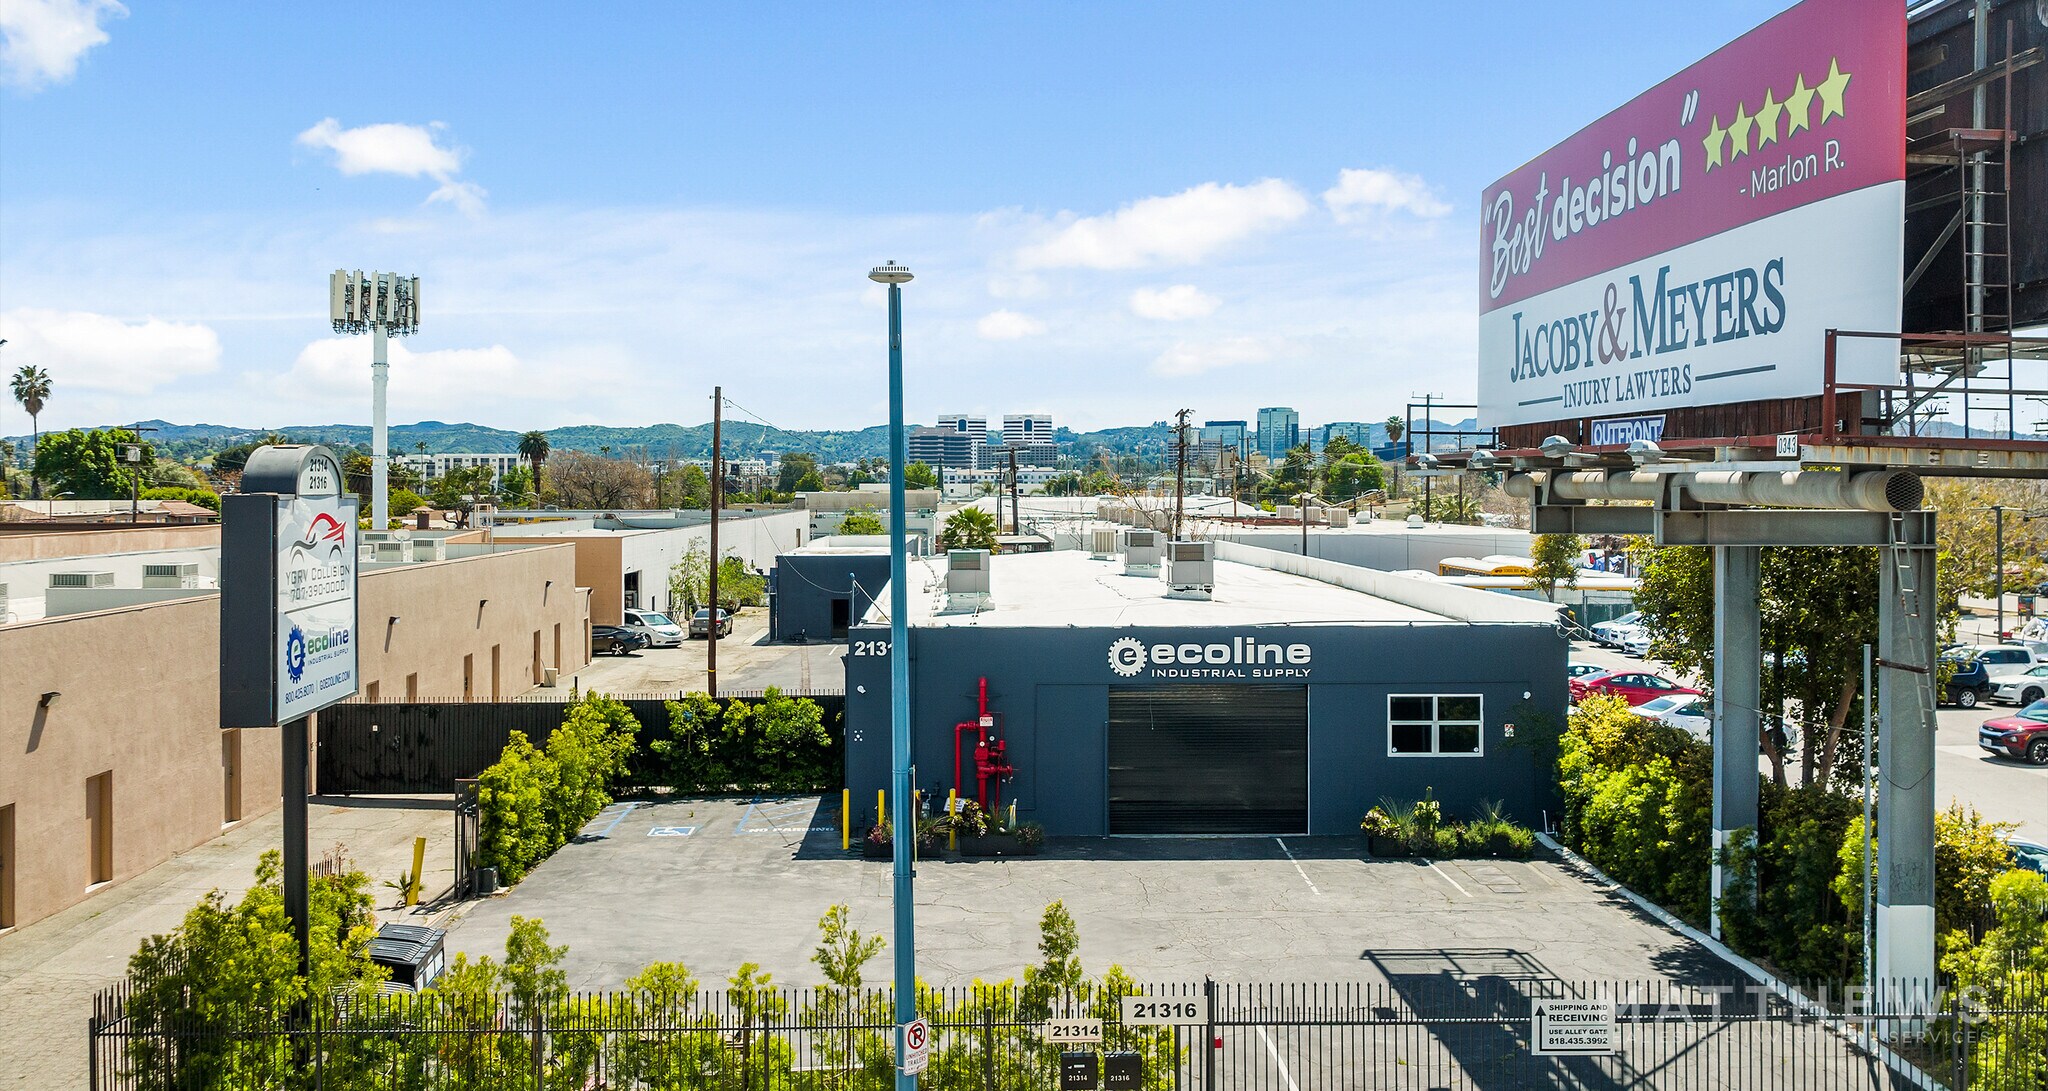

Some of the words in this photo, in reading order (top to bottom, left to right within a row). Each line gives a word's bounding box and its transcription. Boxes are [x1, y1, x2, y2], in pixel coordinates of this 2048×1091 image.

[1752, 154, 1817, 198] Marlon
[1825, 139, 1845, 172] R.
[1563, 377, 1611, 408] INJURY
[1615, 364, 1692, 402] LAWYERS
[1594, 420, 1661, 446] OUTFRONT
[1778, 436, 1797, 454] 0343
[310, 458, 329, 472] 21314
[309, 476, 328, 489] 21316
[308, 627, 349, 655] ecoline
[308, 652, 333, 666] INDUSTRIAL
[334, 647, 349, 658] SUPPLY
[1150, 636, 1312, 664] ecoline
[1151, 669, 1246, 678] INDUSTRIAL
[1252, 669, 1312, 678] SUPPLY
[1133, 1003, 1197, 1018] 21316
[1549, 1014, 1608, 1022] RECEIVING
[1052, 1025, 1100, 1037] 21314
[1549, 1037, 1608, 1045] 818.435.3992
